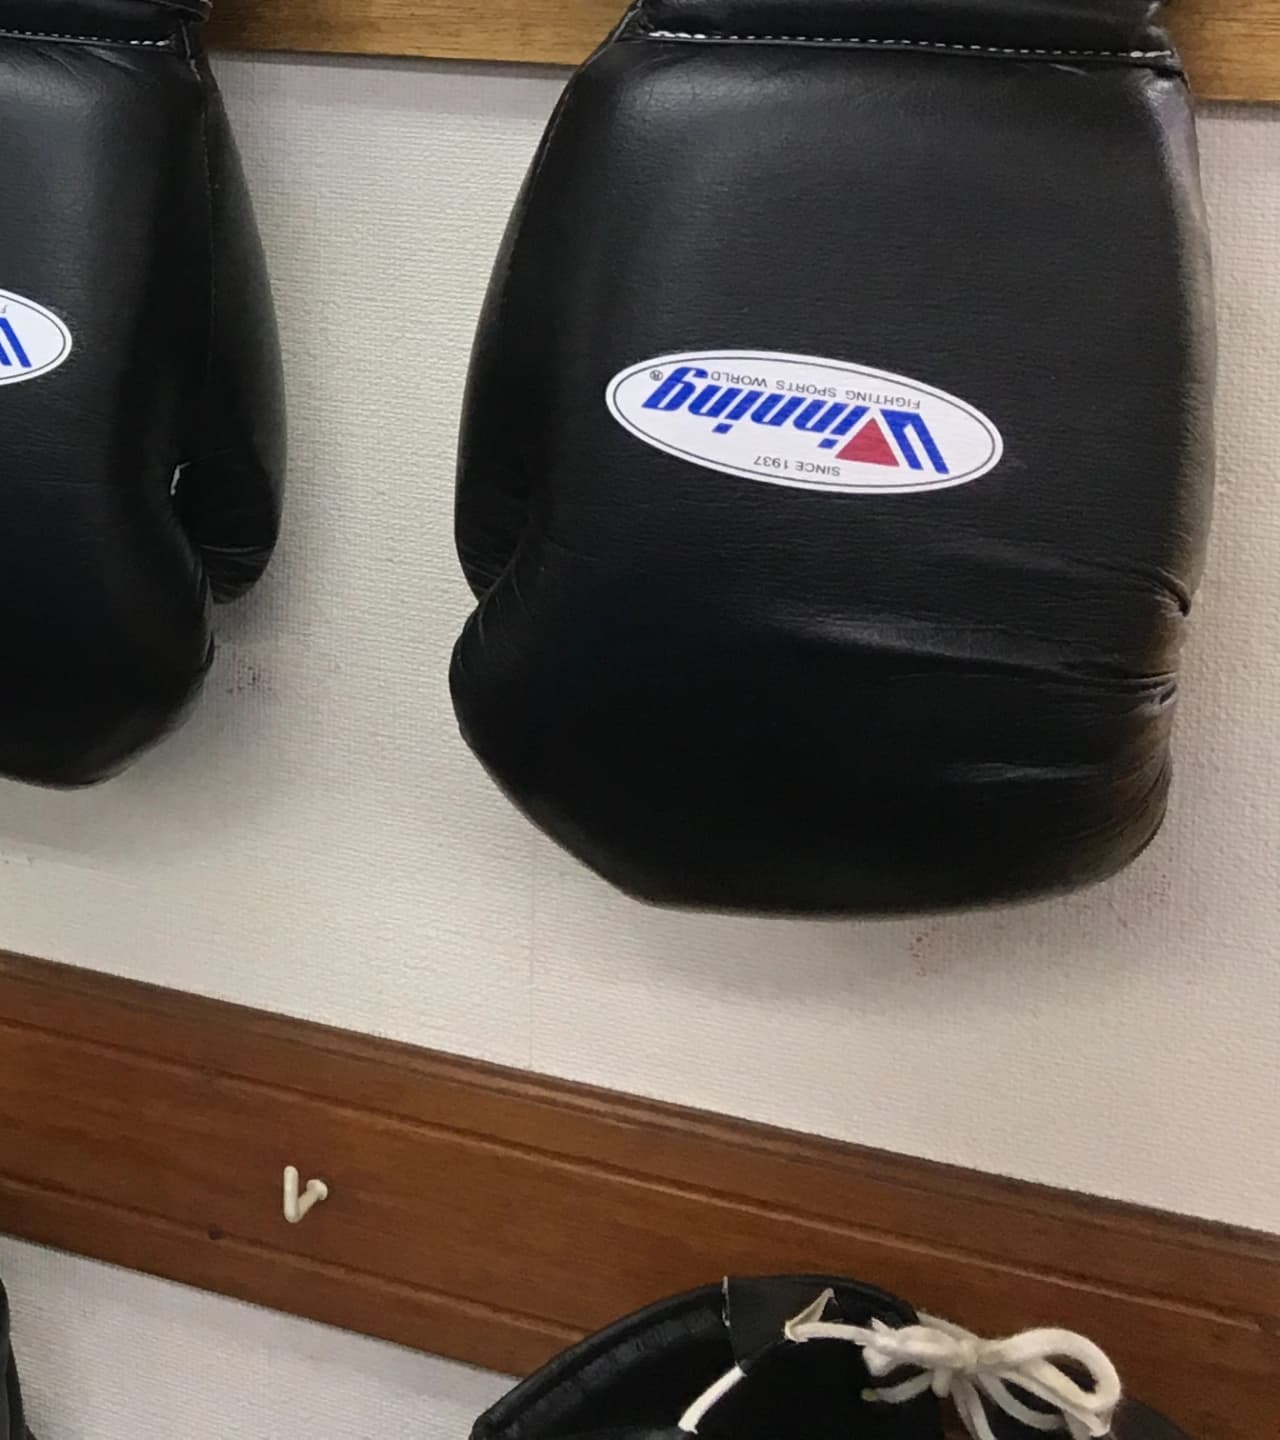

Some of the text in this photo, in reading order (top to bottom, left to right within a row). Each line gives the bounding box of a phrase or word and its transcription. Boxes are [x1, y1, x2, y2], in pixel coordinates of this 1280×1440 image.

[710, 371, 921, 410] FIGHTING SPORTS WORLD
[642, 366, 950, 475] Winning
[753, 455, 841, 477] SINCE 1937
